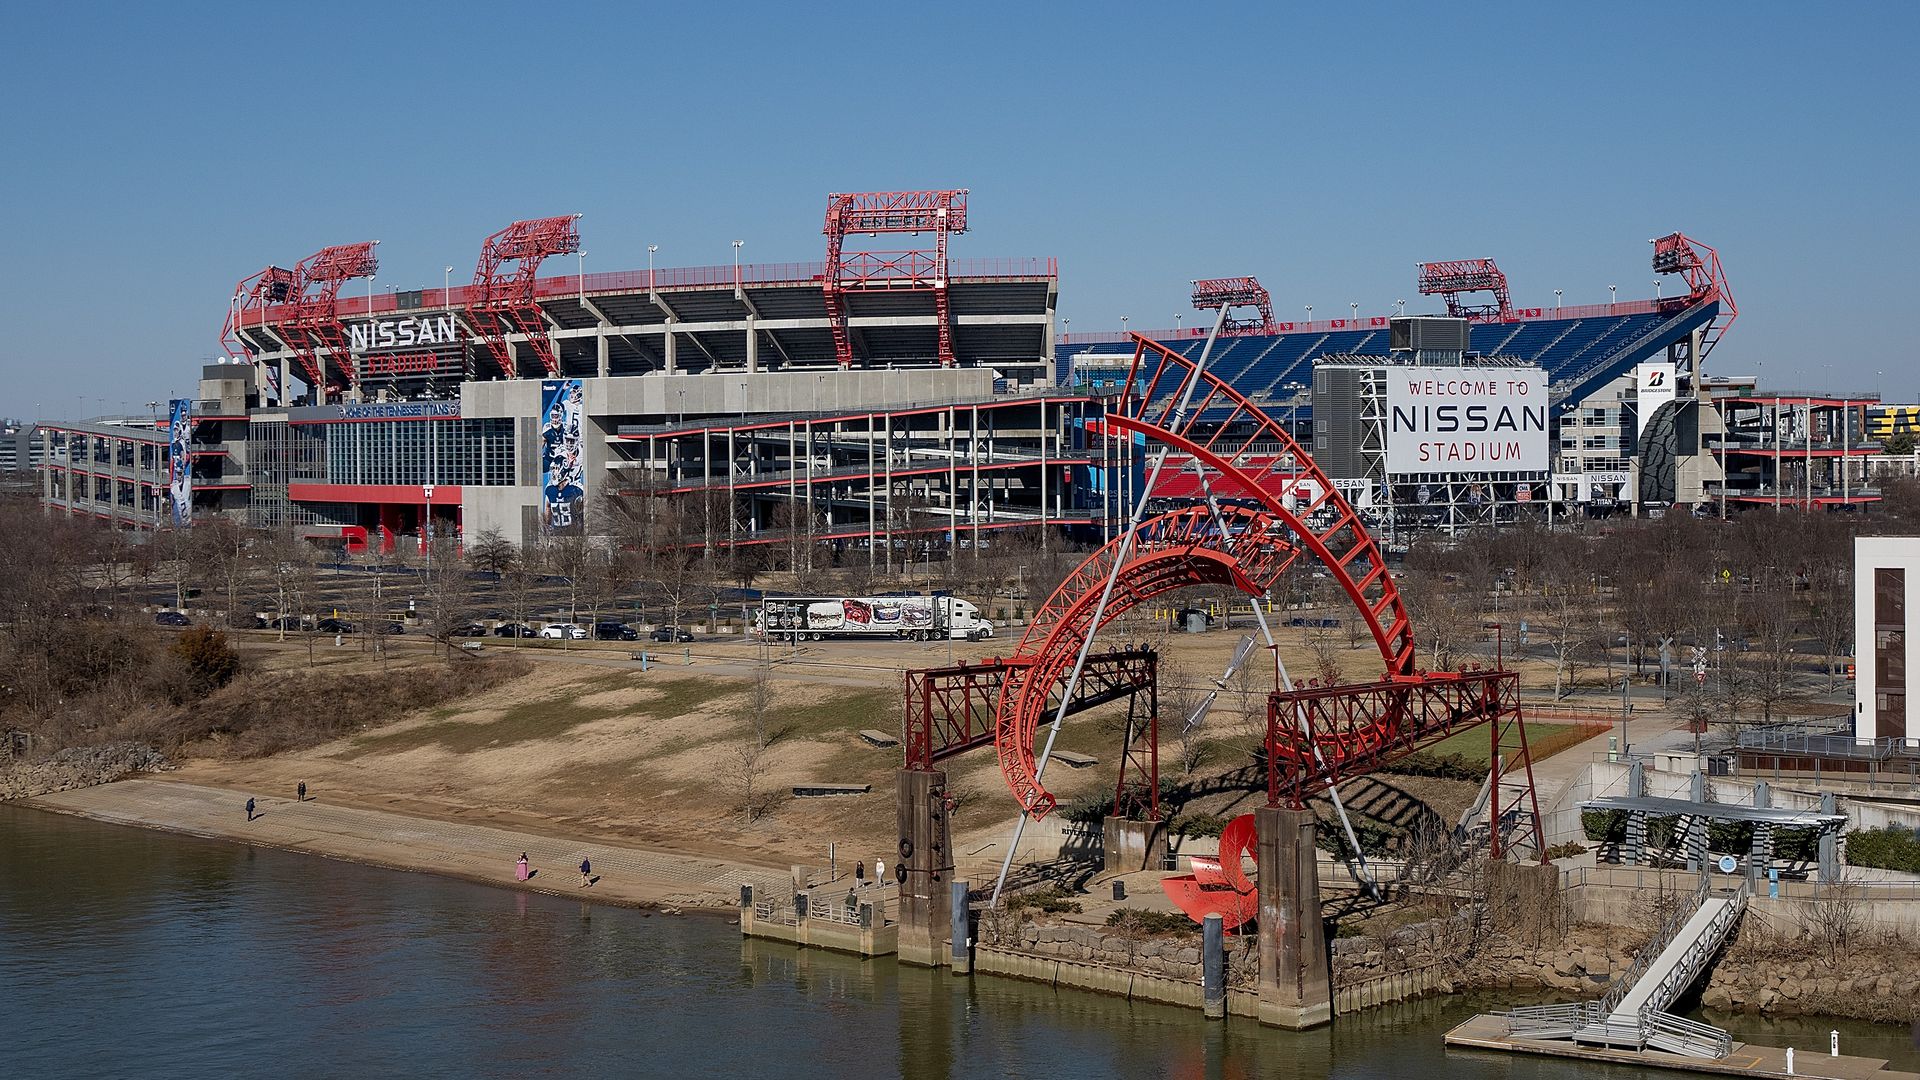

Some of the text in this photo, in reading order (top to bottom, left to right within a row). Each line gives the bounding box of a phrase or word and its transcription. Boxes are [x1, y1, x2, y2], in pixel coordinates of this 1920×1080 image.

[351, 316, 455, 351] NISSAN
[368, 353, 438, 374] STADIUM
[1409, 381, 1529, 395] WELCOME TO
[372, 406, 385, 417] THE
[385, 404, 422, 416] TENNESSEE
[424, 403, 449, 415] TTANS
[1393, 405, 1545, 432] NISSAN
[1419, 442, 1521, 462] STADIUM
[1333, 480, 1365, 488] ISSAN
